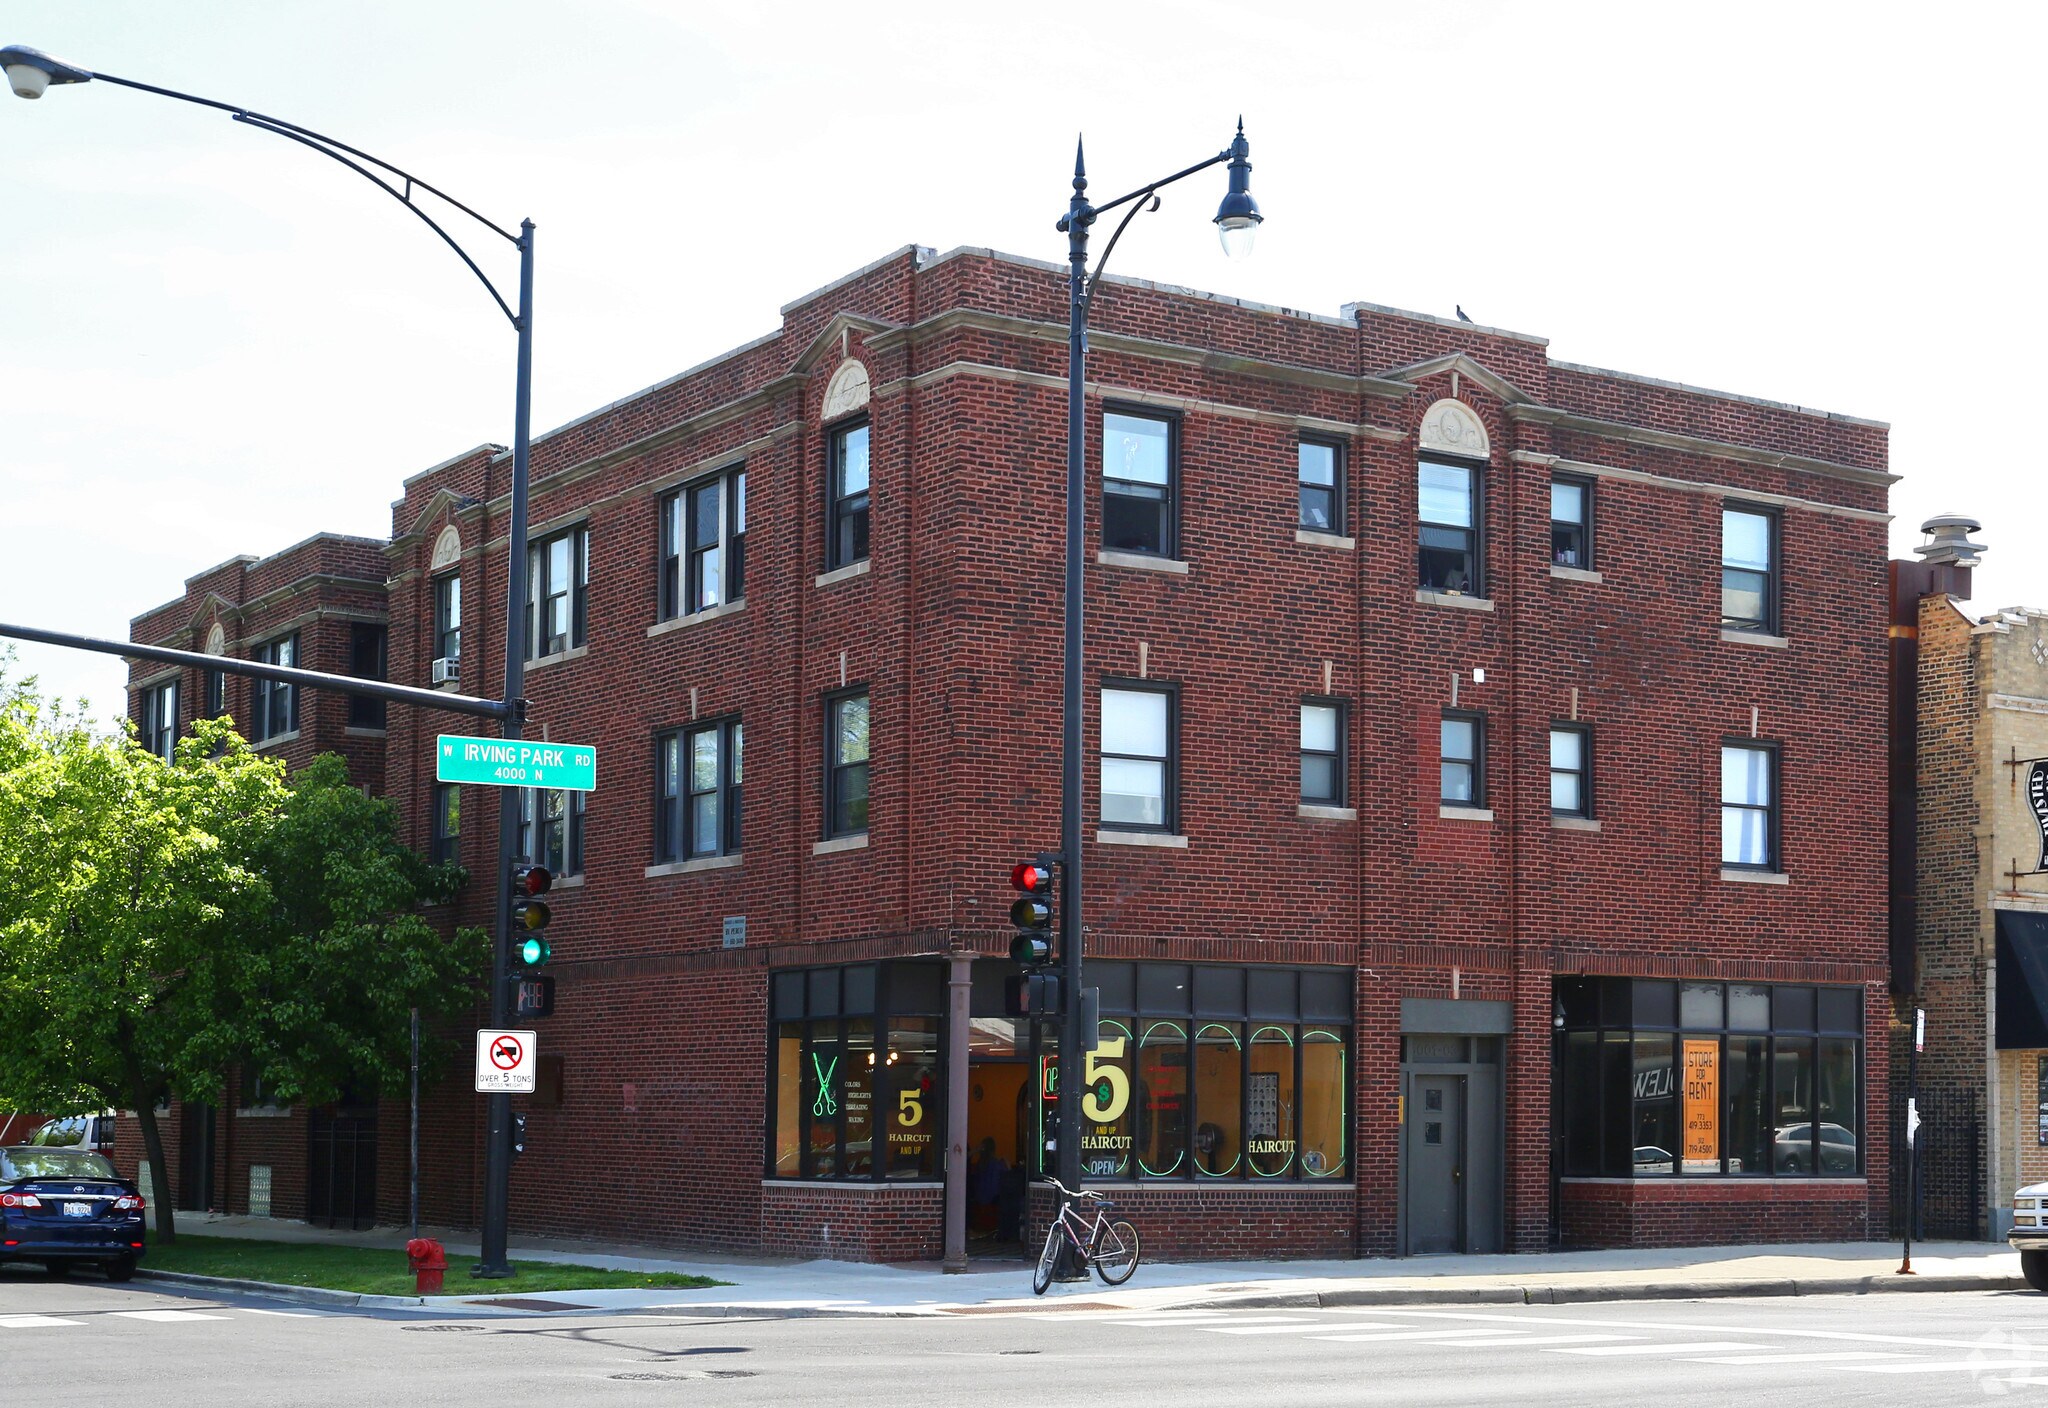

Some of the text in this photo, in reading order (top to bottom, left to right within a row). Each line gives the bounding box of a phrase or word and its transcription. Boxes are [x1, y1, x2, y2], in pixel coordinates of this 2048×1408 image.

[444, 744, 591, 767] W IRVING PARK RD
[494, 767, 543, 780] 4000 N
[1689, 1052, 1712, 1068] STORE
[479, 1072, 532, 1083] OVER 5 TONS
[1045, 1067, 1058, 1092] OP
[1082, 1036, 1130, 1122] 5
[1696, 1069, 1706, 1080] FOR
[1098, 1083, 1110, 1103] $
[1689, 1082, 1713, 1100] RENT
[898, 1088, 923, 1127] 5
[848, 1116, 865, 1124] WAXING
[1096, 1126, 1117, 1135] AND UP
[888, 1133, 932, 1143] HAIRCUT
[1081, 1136, 1133, 1149] HAIRCUT
[900, 1146, 922, 1155] AND UP
[1248, 1140, 1296, 1153] HAIRCUT
[1090, 1160, 1115, 1175] OPEN
